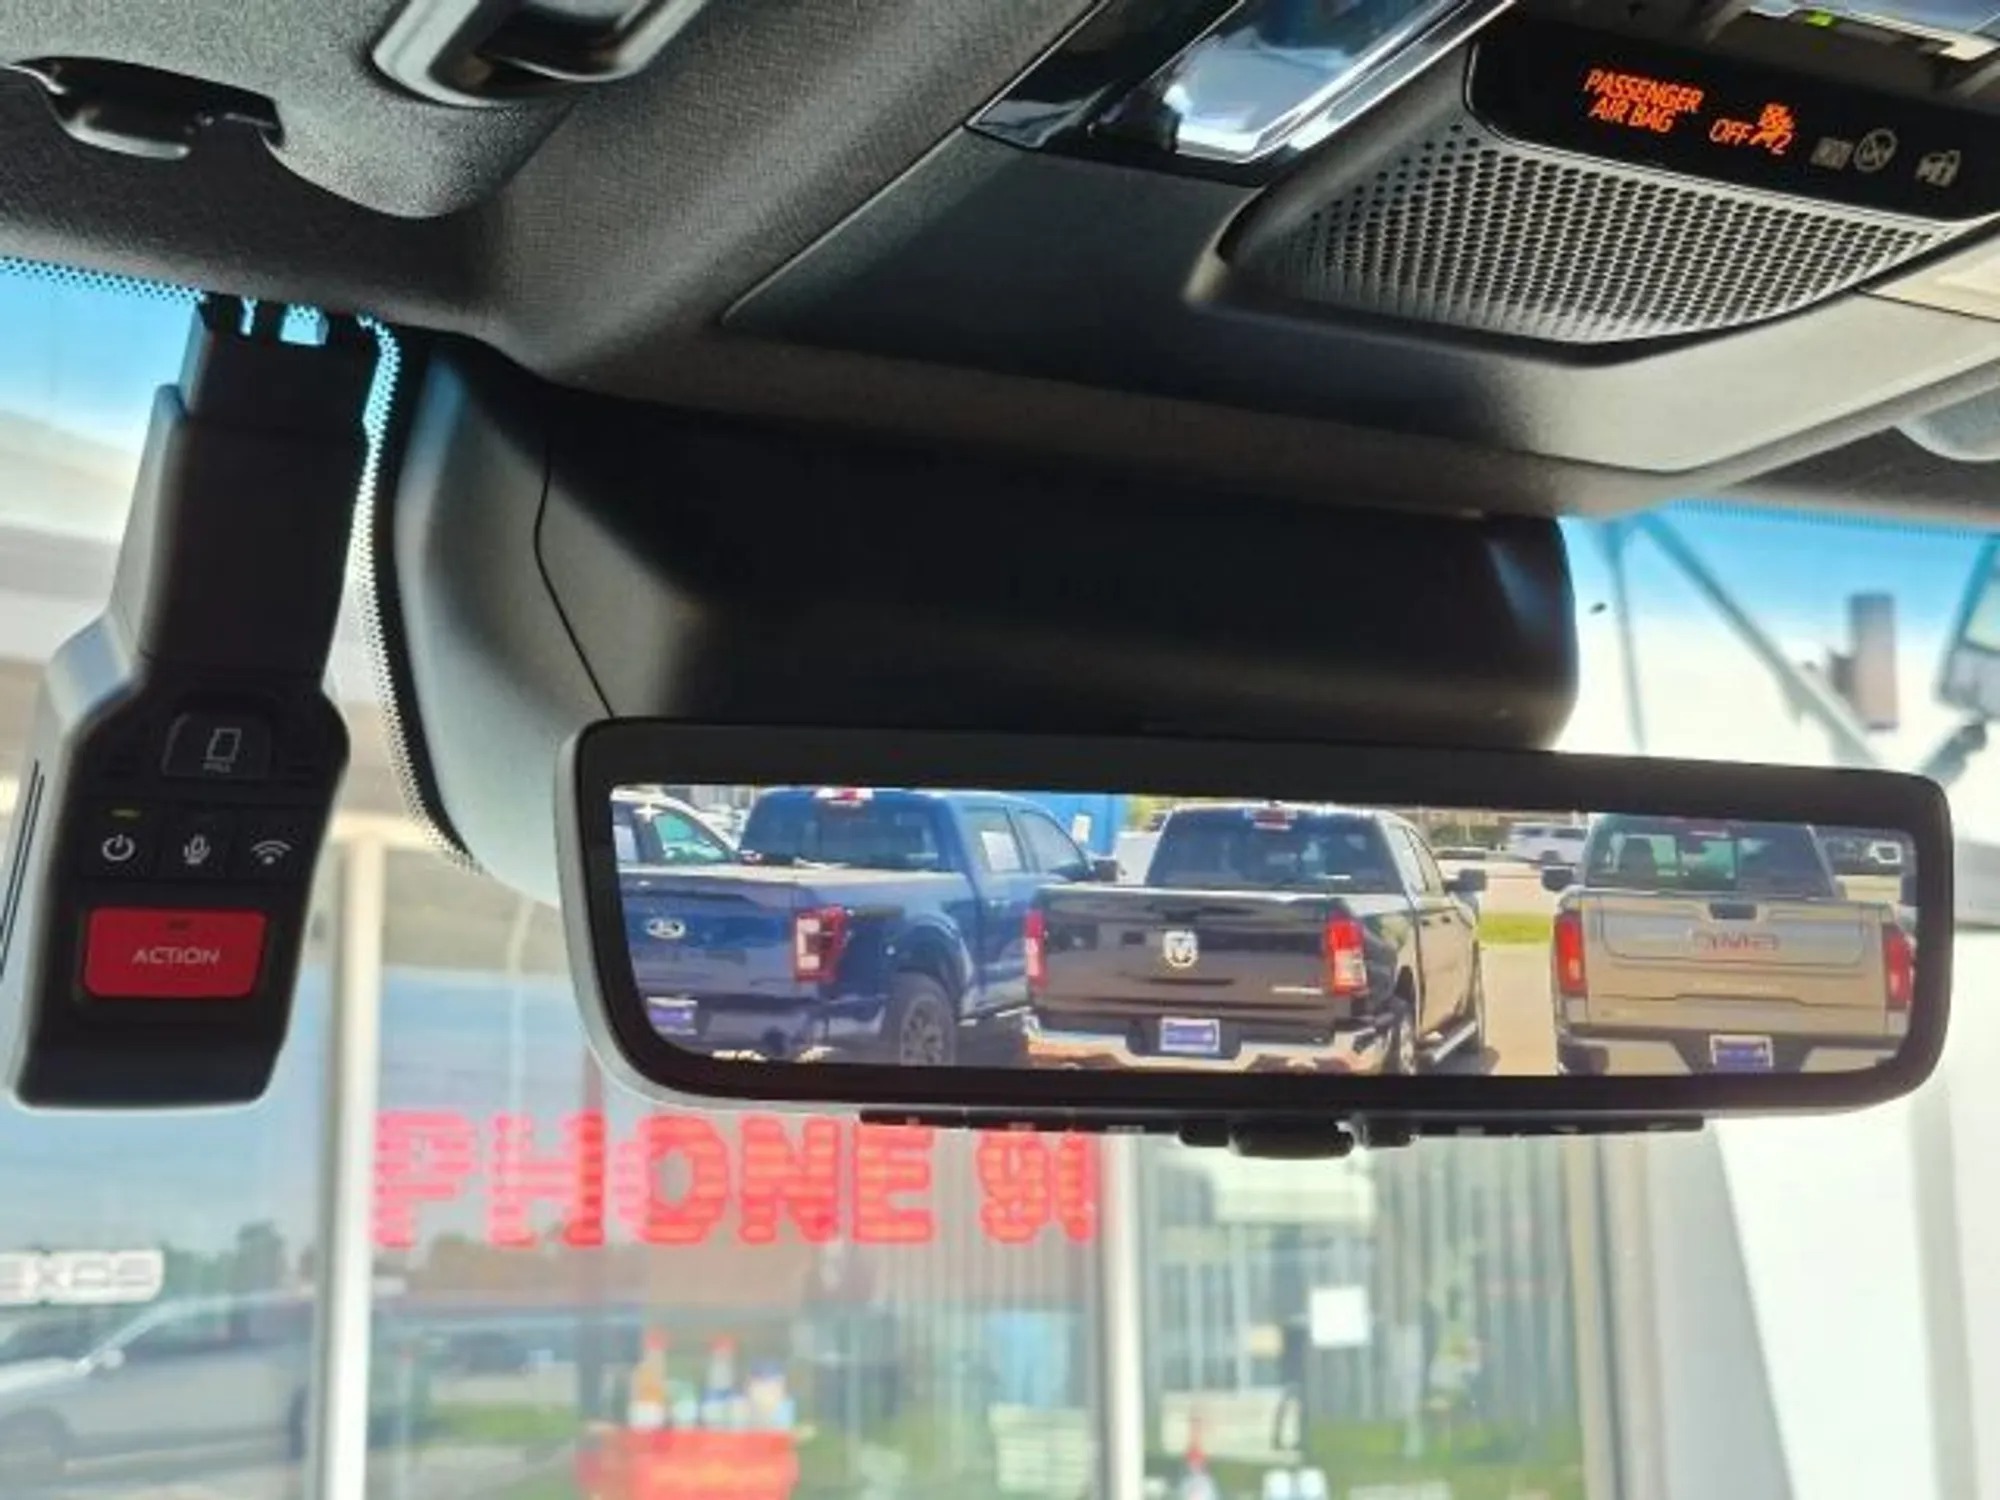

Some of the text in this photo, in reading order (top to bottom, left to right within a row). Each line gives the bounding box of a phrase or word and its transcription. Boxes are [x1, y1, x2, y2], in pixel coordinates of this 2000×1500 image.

[1584, 68, 1704, 113] PASSENGER
[1588, 97, 1676, 133] AIR BAG
[1709, 118, 1753, 144] OFF
[131, 946, 220, 965] ACTION
[373, 1108, 932, 1247] PHONE
